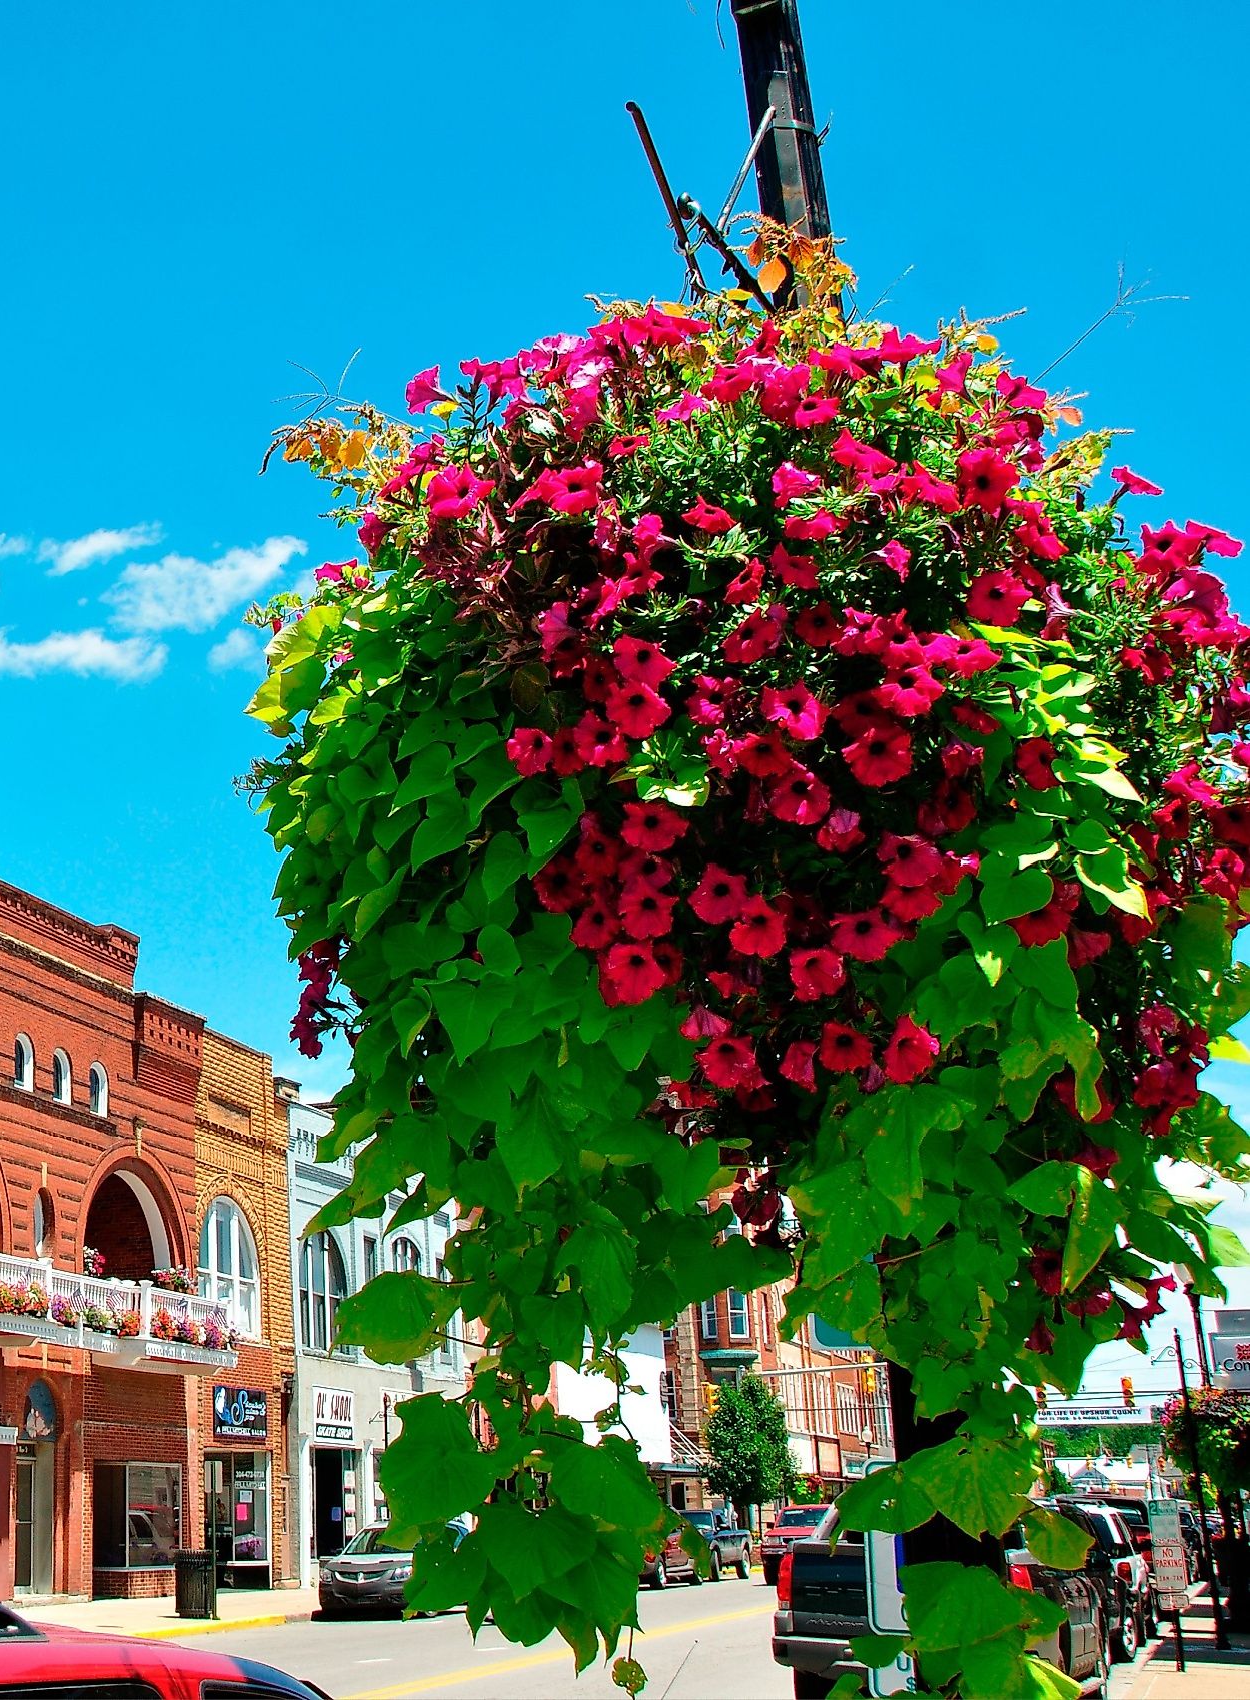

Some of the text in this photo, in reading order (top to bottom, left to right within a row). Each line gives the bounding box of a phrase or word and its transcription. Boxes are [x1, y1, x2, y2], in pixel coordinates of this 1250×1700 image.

[316, 1425, 352, 1439] SKATE SHOP
[1162, 1547, 1174, 1558] NO
[1156, 1558, 1183, 1568] PARKING
